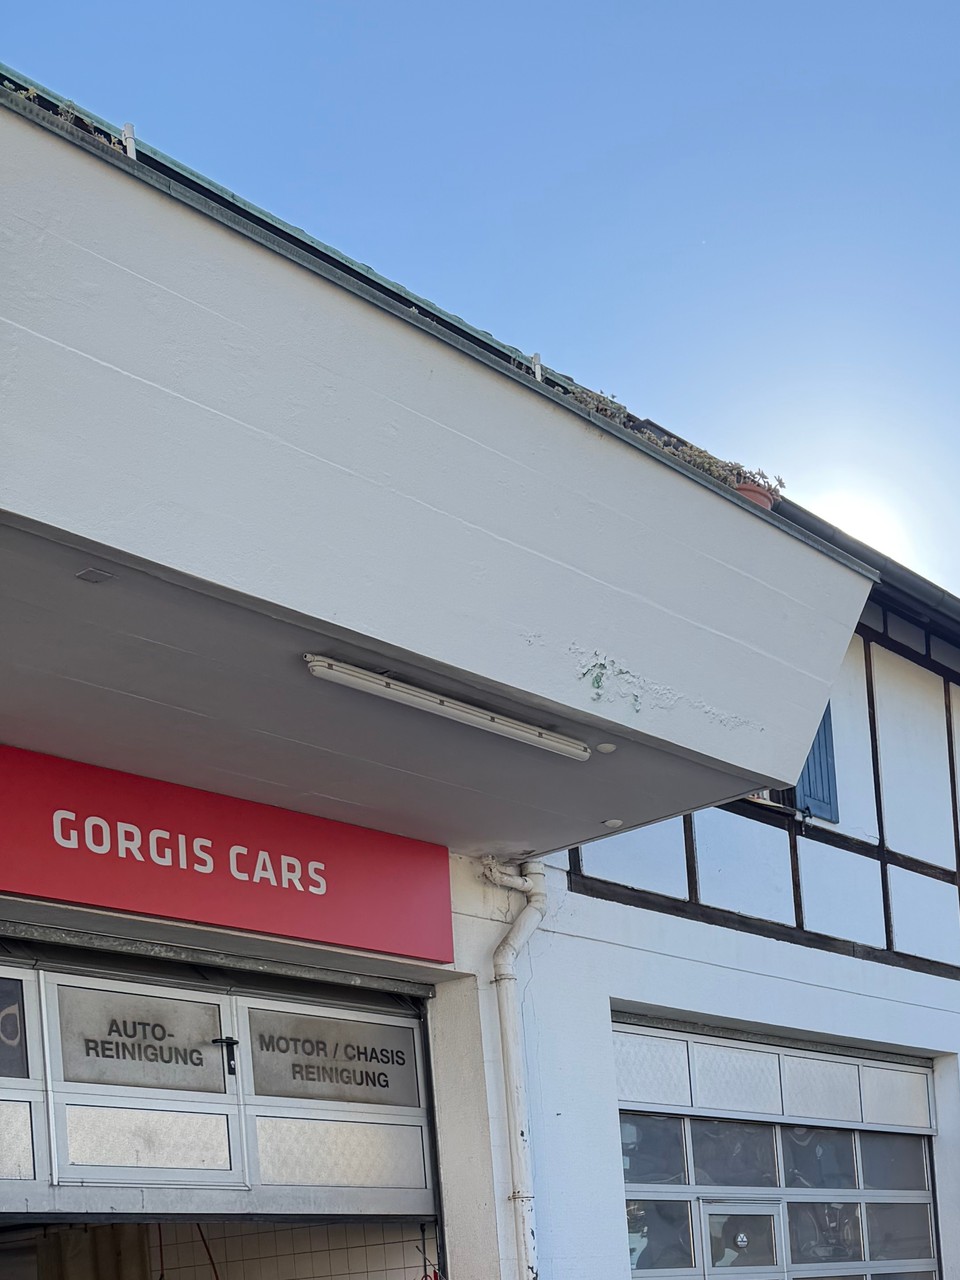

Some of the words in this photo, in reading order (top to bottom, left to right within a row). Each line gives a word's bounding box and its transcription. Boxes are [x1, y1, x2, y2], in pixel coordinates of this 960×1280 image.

[52, 809, 214, 874] GORGIS
[229, 845, 327, 895] CARS
[107, 1019, 175, 1042] AUTO-
[84, 1037, 205, 1067] REINIGUNG
[259, 1033, 328, 1060] MOTOR
[332, 1042, 340, 1060] /
[344, 1043, 406, 1067] CHASIS
[292, 1063, 390, 1088] REINIGUNG
